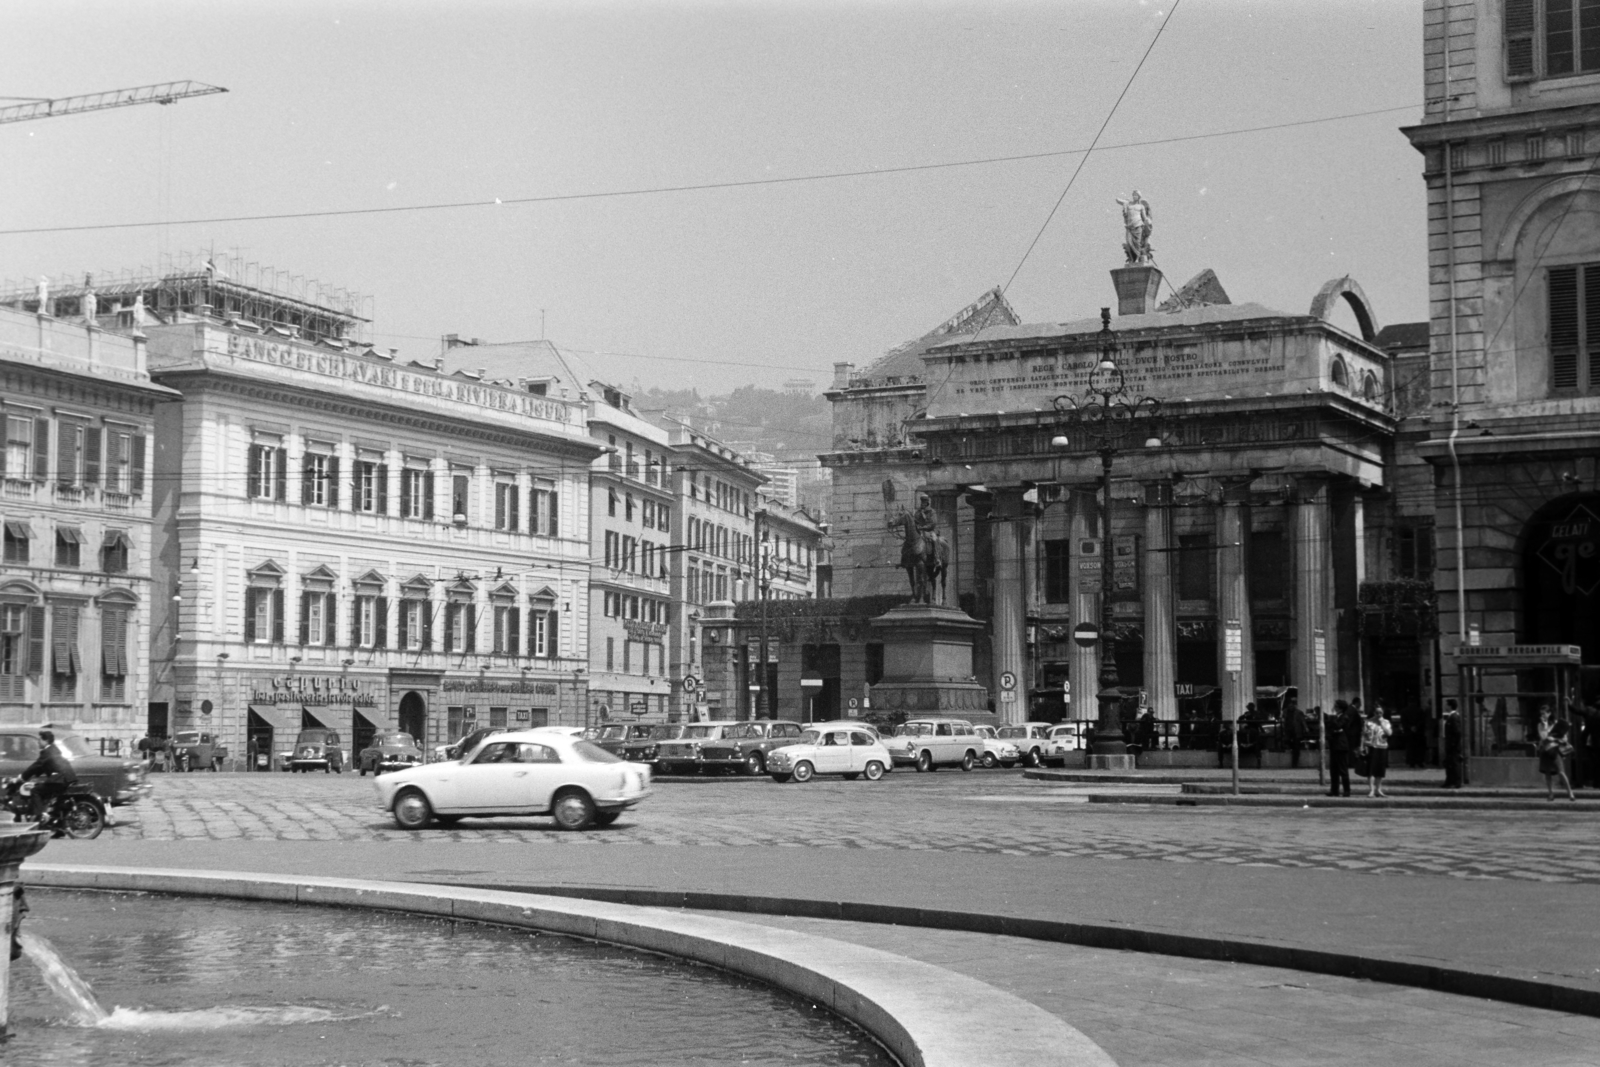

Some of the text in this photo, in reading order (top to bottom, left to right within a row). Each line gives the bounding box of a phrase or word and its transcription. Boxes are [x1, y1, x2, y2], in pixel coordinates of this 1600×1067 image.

[1061, 361, 1094, 371] CAROLO
[227, 333, 293, 365] BANCO
[296, 350, 313, 371] DI
[316, 354, 397, 388] CHIAVARI
[413, 377, 454, 399] DELLA
[456, 383, 517, 412] RIVIERA
[522, 397, 573, 424] LIGURE
[1551, 523, 1588, 538] GELATI
[1079, 561, 1102, 570] VOXSON
[1459, 646, 1500, 655] CORRIERE
[1507, 646, 1562, 655] MERCANTILE
[1175, 684, 1193, 695] TAXI
[517, 711, 529, 720] TAXI
